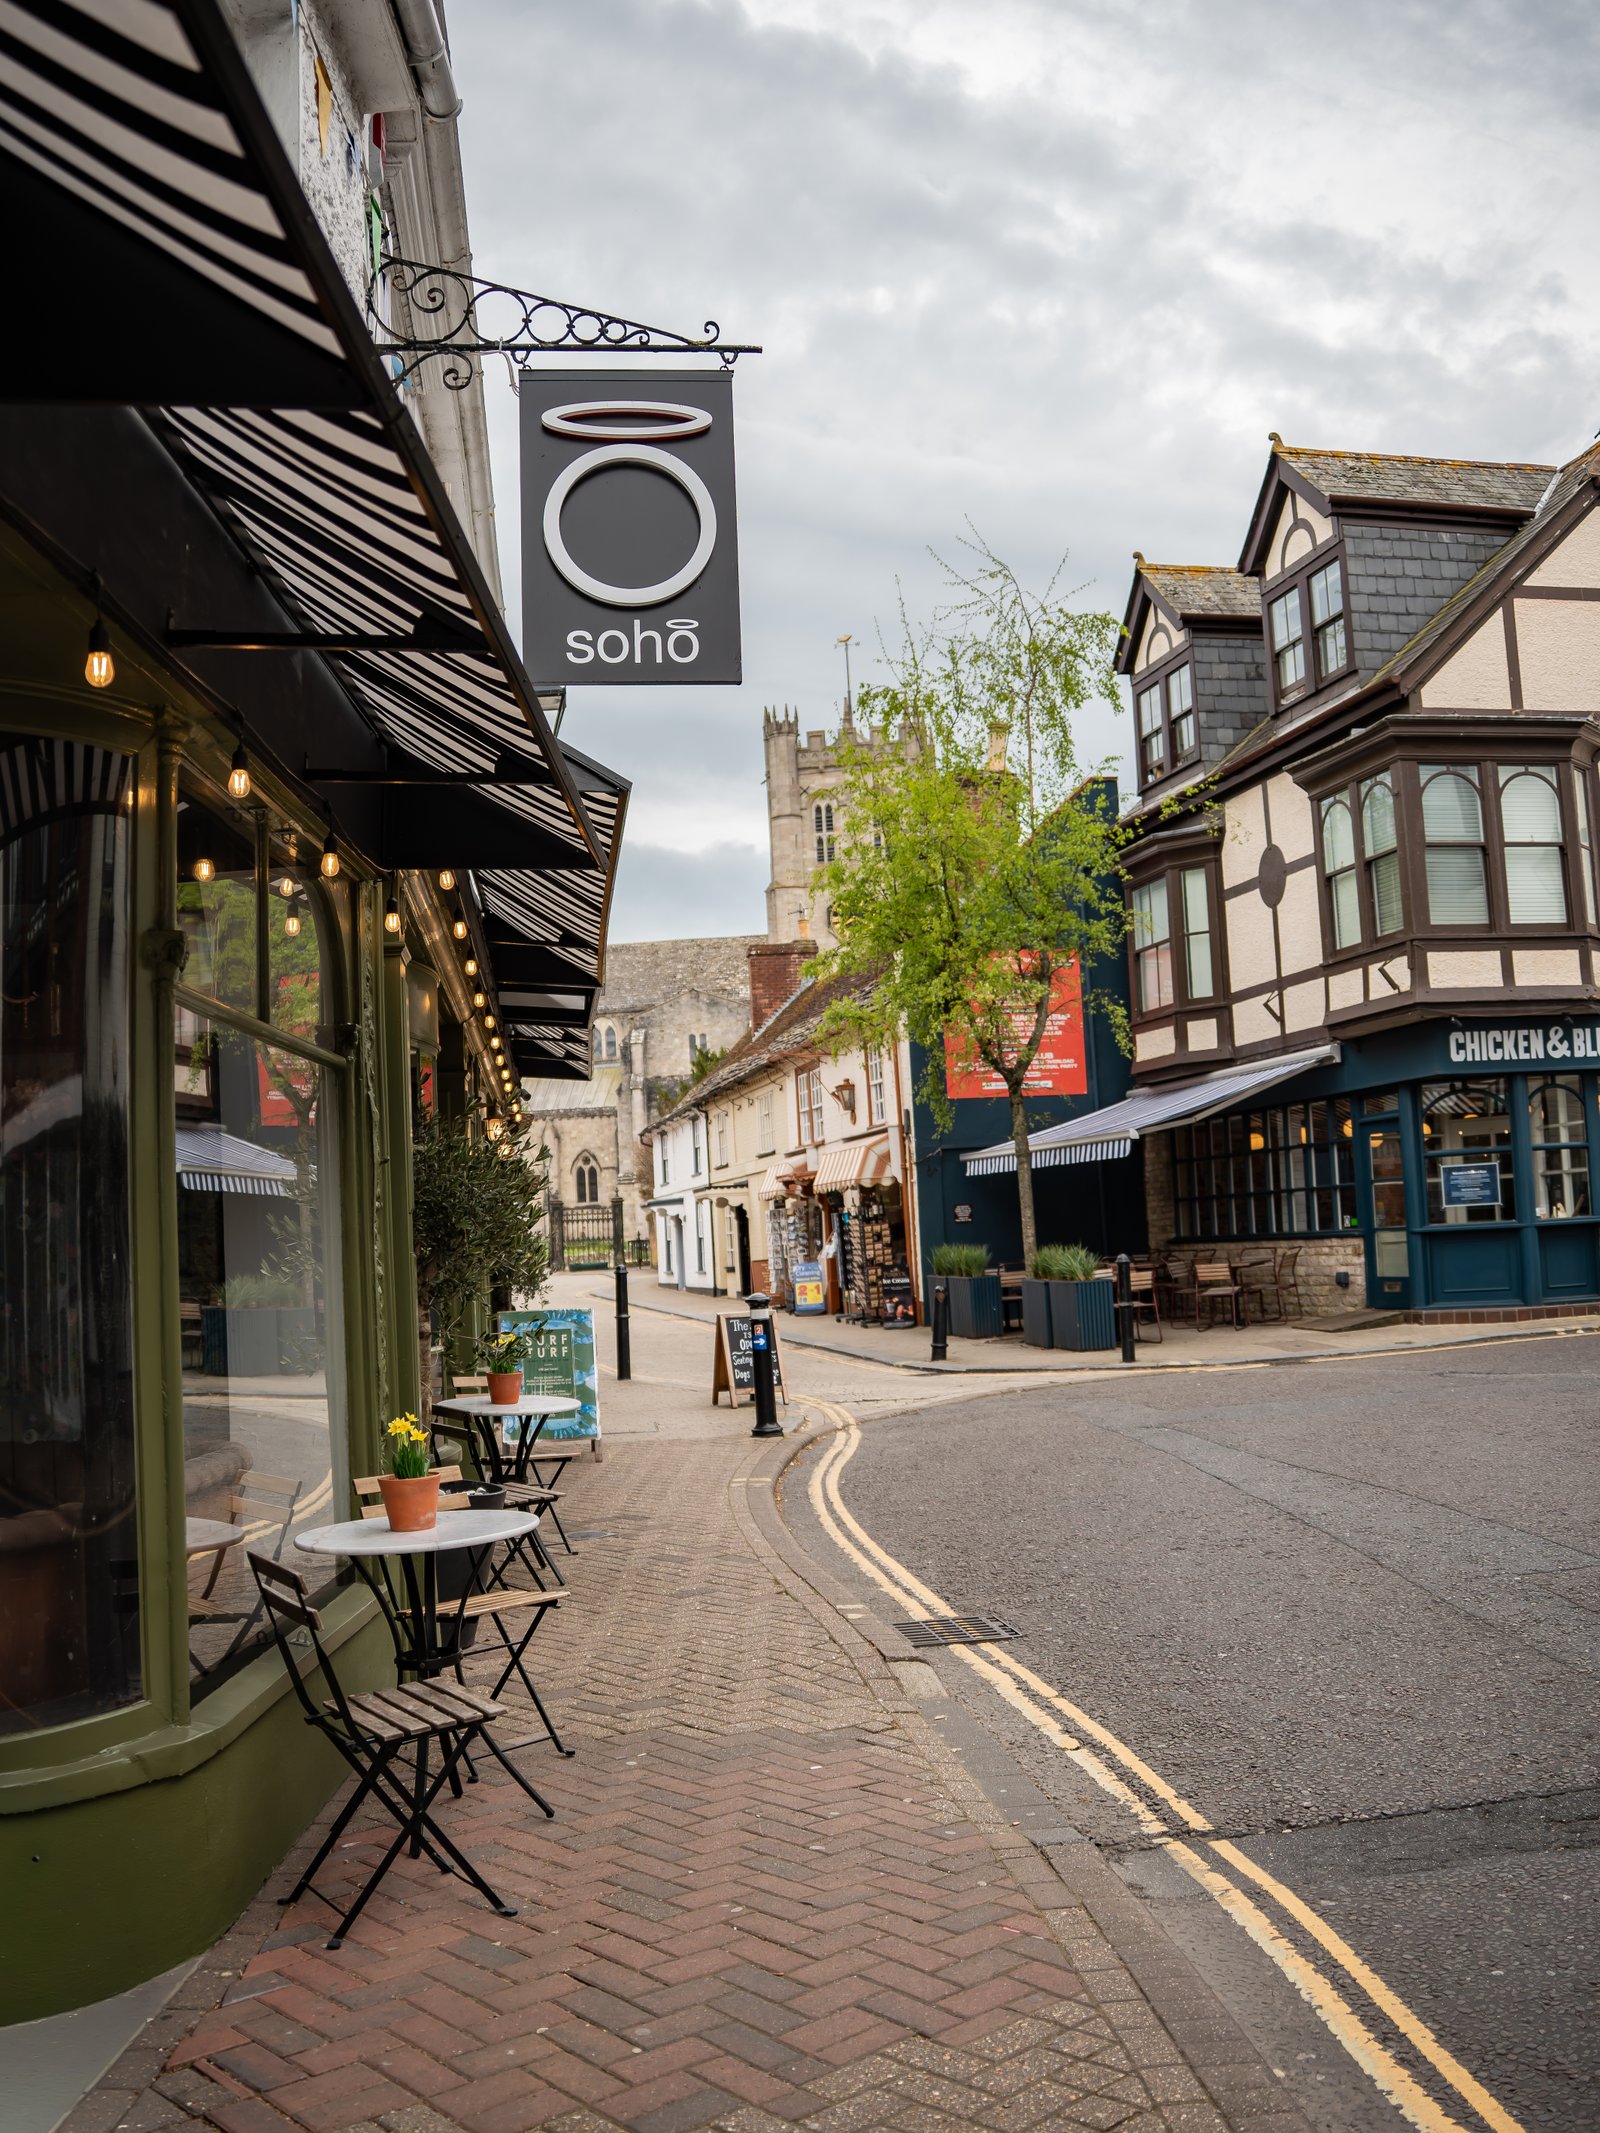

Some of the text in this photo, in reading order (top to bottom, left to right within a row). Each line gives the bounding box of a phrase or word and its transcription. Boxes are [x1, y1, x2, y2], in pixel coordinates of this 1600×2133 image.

[1449, 1029, 1545, 1062] CHICKEN
[1546, 1026, 1571, 1059] &
[797, 1284, 808, 1297] 2
[814, 1283, 821, 1296] 1
[729, 1319, 749, 1332] The
[525, 1333, 568, 1347] SURF
[526, 1346, 568, 1359] TURF
[734, 1369, 751, 1383] Dogs
